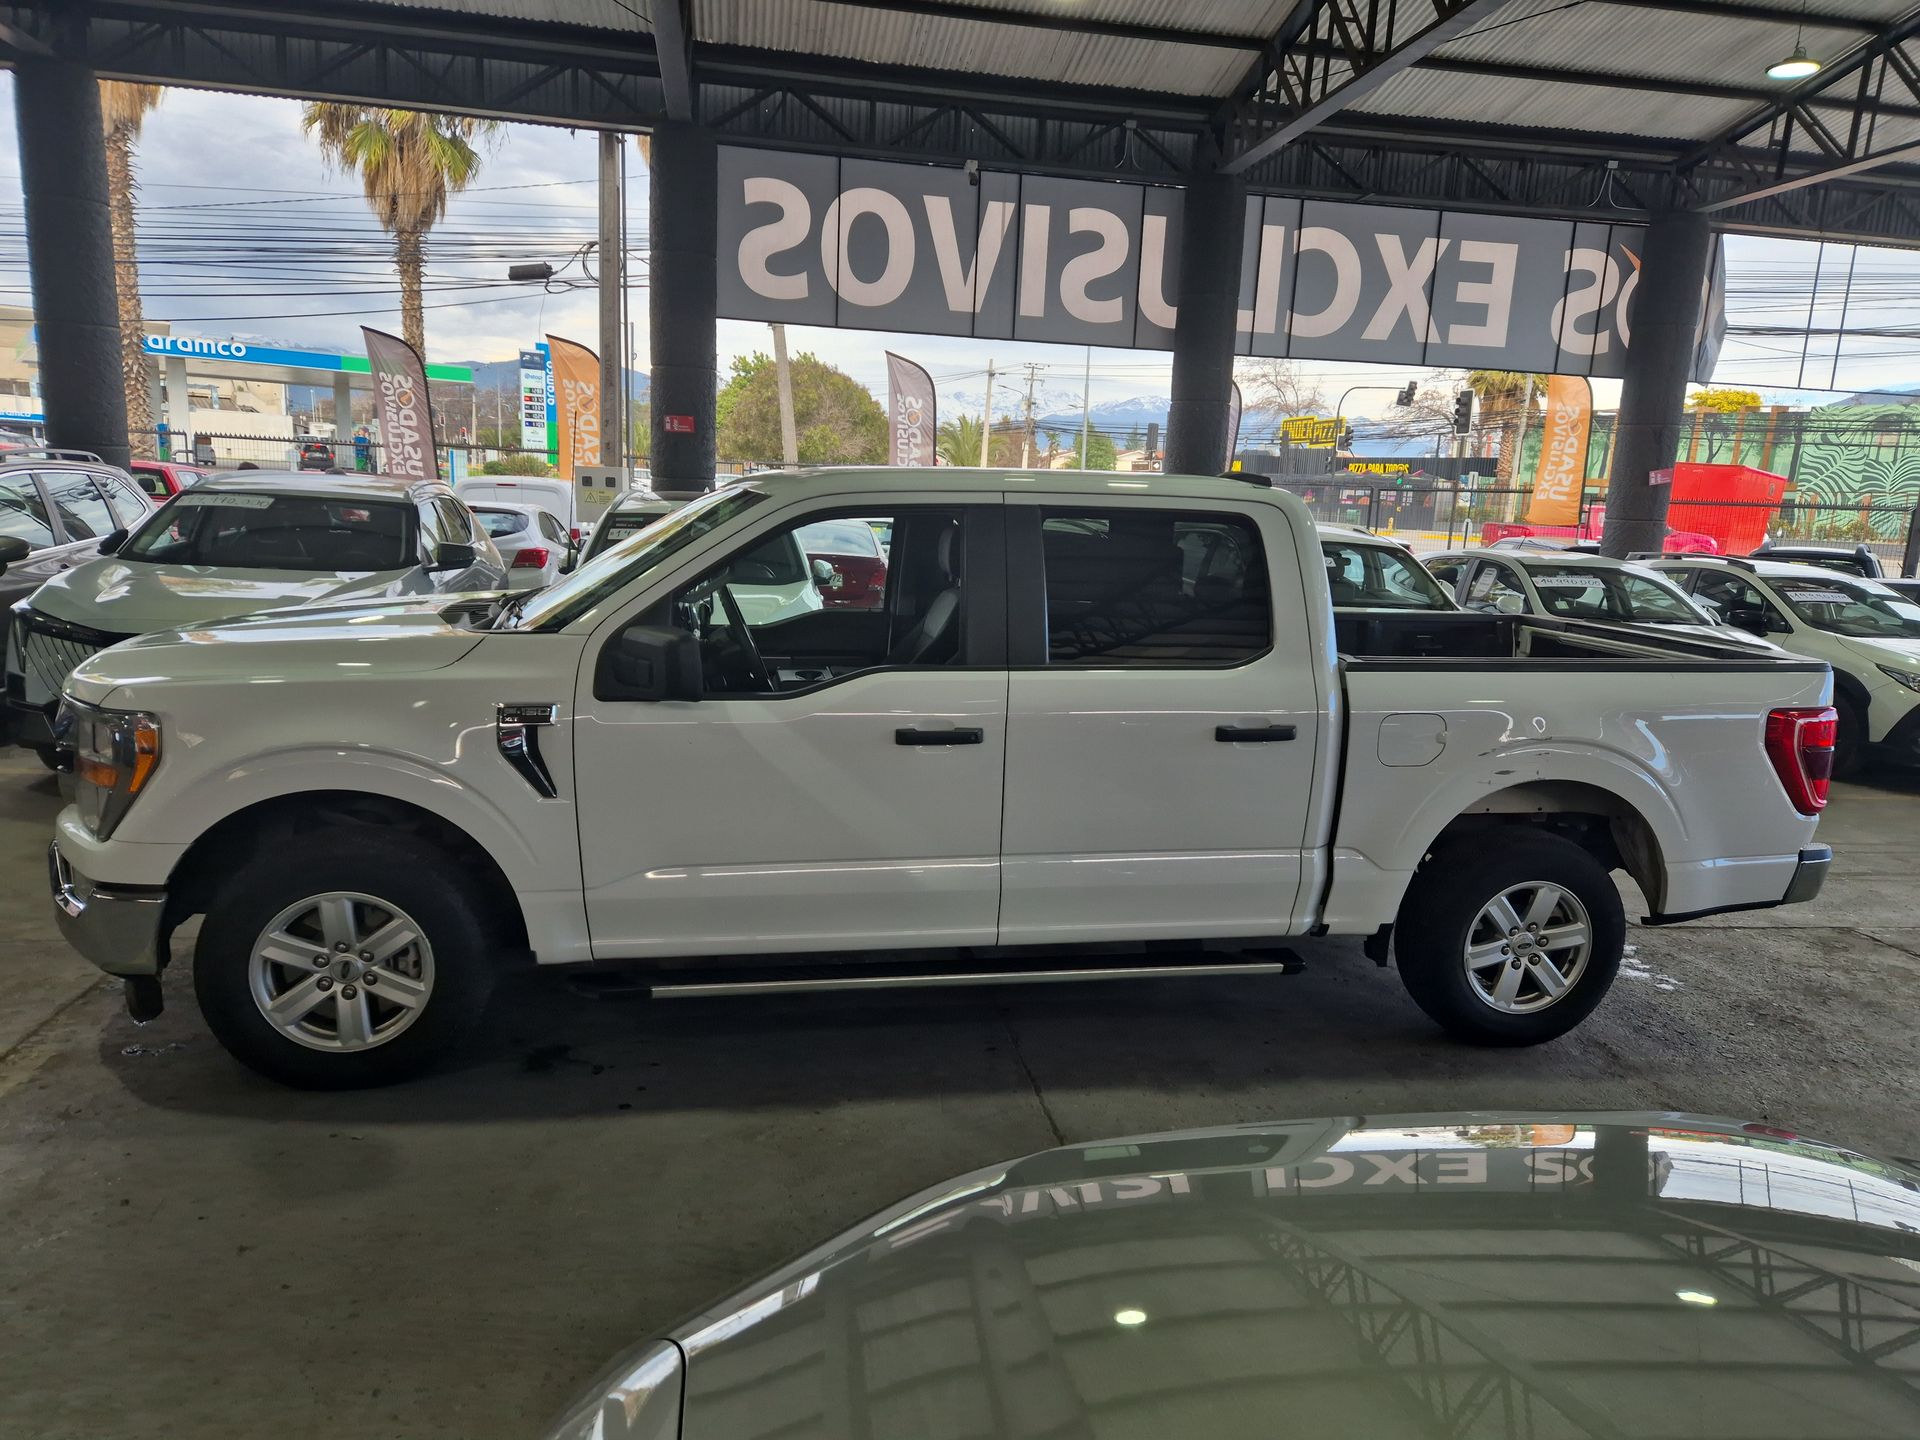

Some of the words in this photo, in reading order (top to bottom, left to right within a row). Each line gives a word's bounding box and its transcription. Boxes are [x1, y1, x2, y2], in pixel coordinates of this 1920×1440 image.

[147, 334, 247, 357] aramco
[1348, 463, 1366, 474] PIZZA
[1367, 463, 1384, 475] PARA
